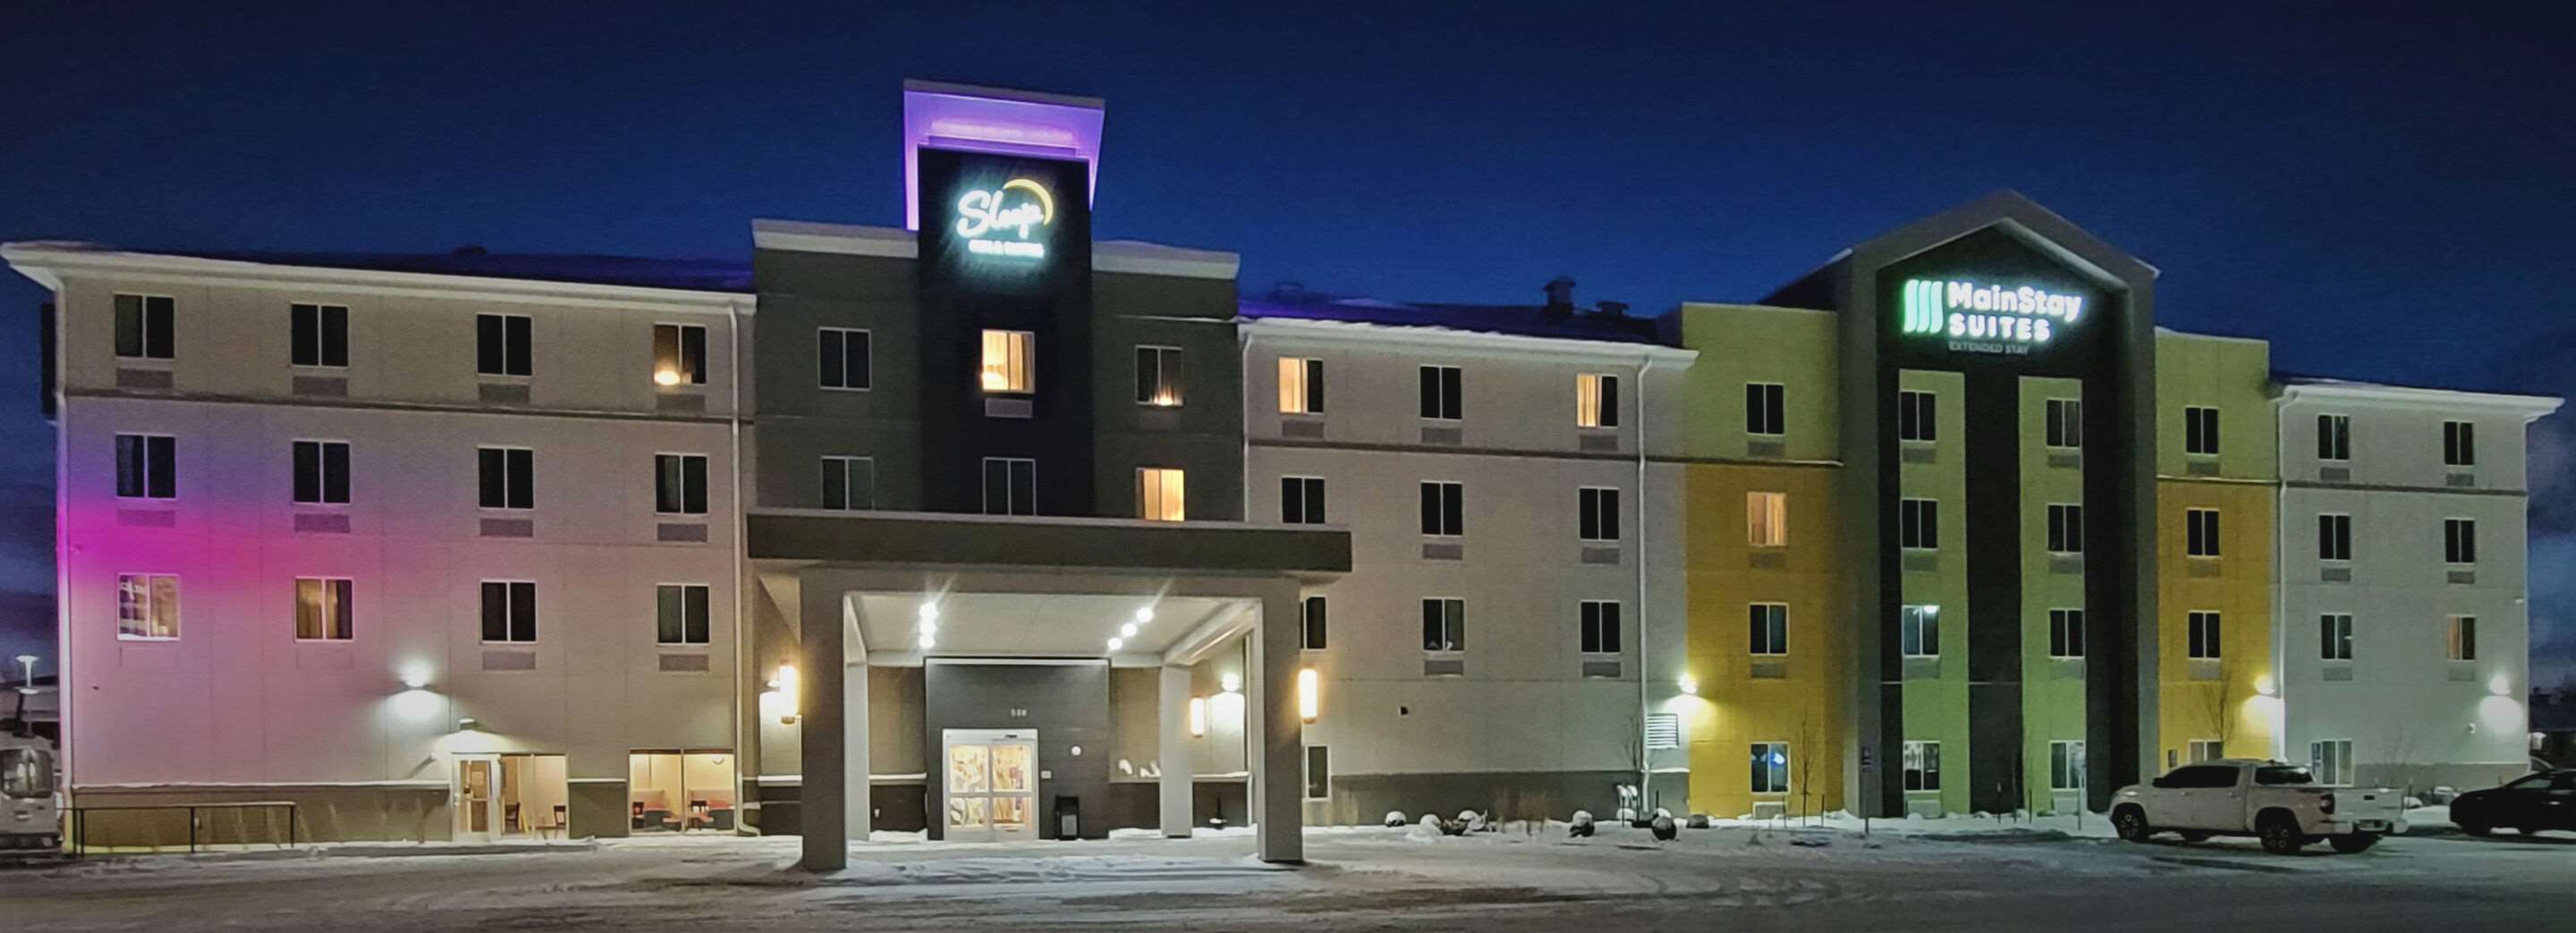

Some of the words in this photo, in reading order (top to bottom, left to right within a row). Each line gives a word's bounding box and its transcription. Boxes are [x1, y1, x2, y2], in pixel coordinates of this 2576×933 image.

[1947, 281, 2082, 322] MainStay
[1949, 313, 2050, 341] SUITES
[1949, 342, 2003, 352] EXTENDED
[2004, 344, 2029, 355] STAY
